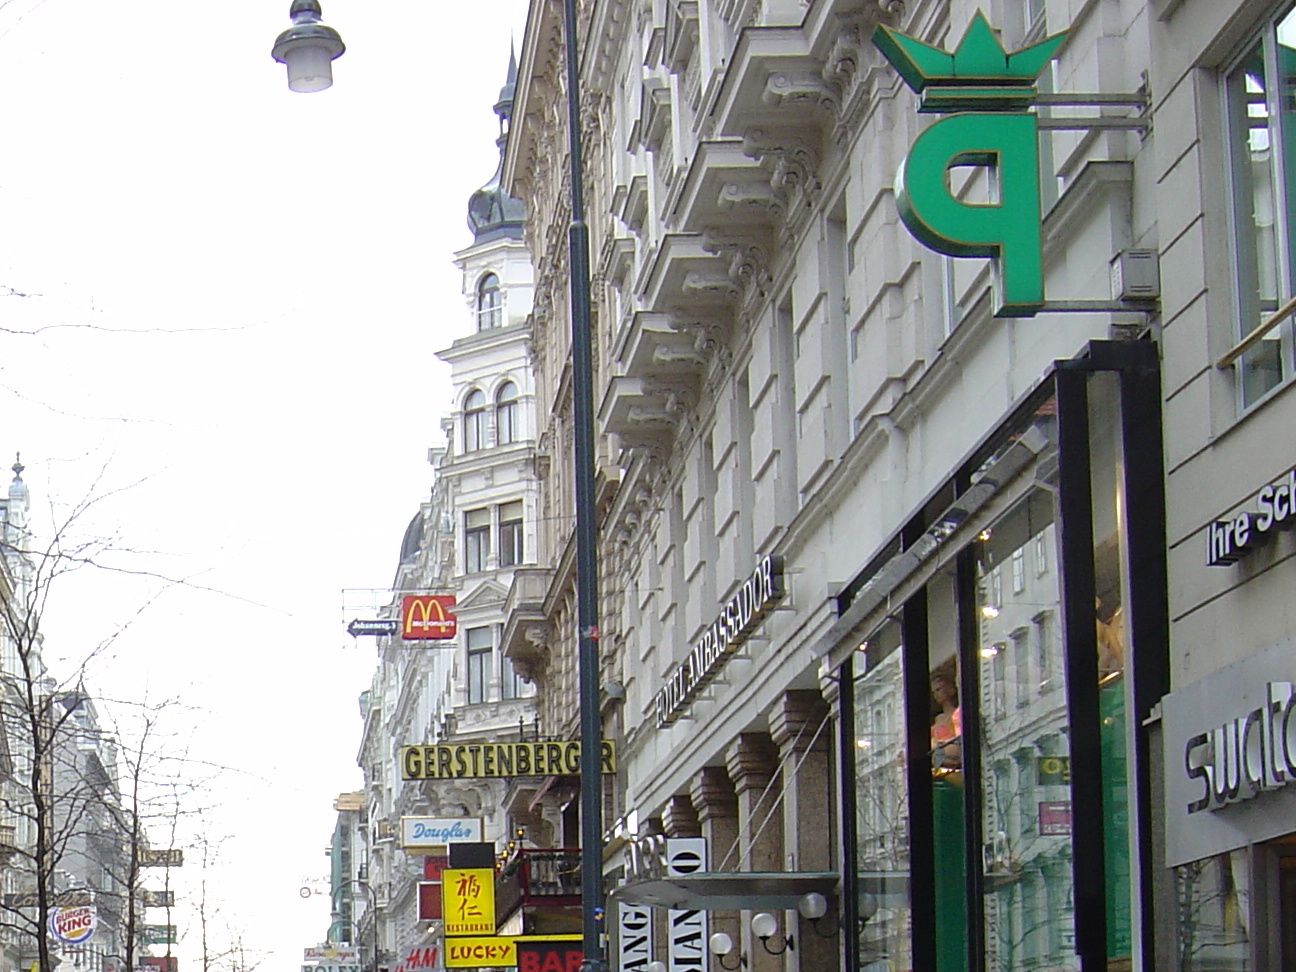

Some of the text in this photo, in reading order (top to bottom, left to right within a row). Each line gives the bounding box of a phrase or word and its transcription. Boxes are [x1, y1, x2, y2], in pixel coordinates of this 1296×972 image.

[1206, 512, 1250, 566] Ihre
[655, 555, 772, 729] HOTEL AMBASSADOR
[405, 744, 614, 778] GERSTENBERGR
[412, 822, 473, 842] Douglas
[56, 908, 90, 925] BURGER
[58, 915, 92, 935] KING
[406, 948, 438, 969] H&M
[450, 946, 511, 960] LUCKY
